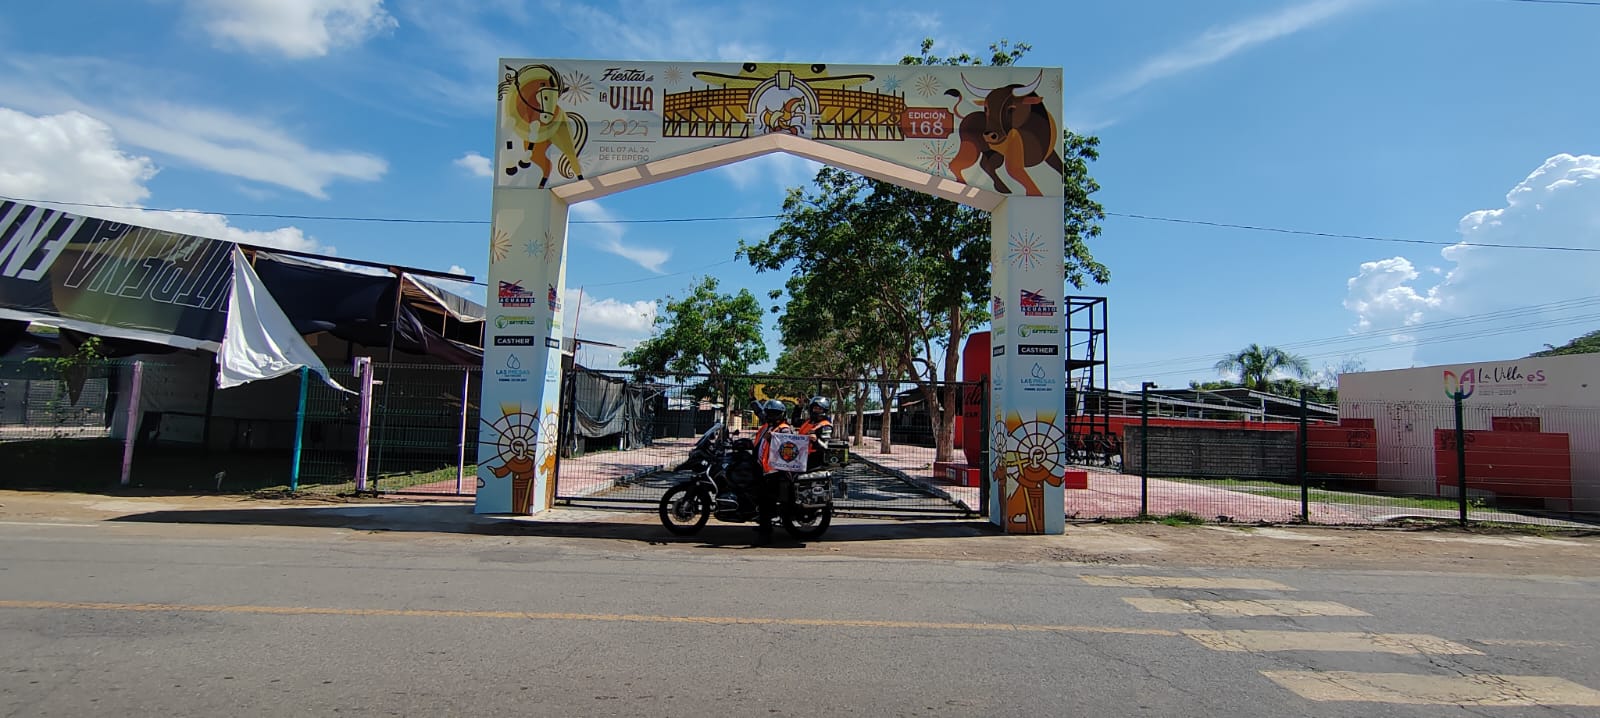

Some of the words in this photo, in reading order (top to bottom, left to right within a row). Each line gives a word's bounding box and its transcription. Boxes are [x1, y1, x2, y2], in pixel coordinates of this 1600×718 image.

[600, 68, 646, 82] Fiestas
[599, 91, 608, 103] LA
[609, 85, 654, 111] VILLA
[908, 111, 946, 120] EDICIÓN
[600, 119, 649, 137] 2025
[909, 120, 945, 136] 168
[1478, 367, 1491, 384] La
[1494, 366, 1524, 383] Villa
